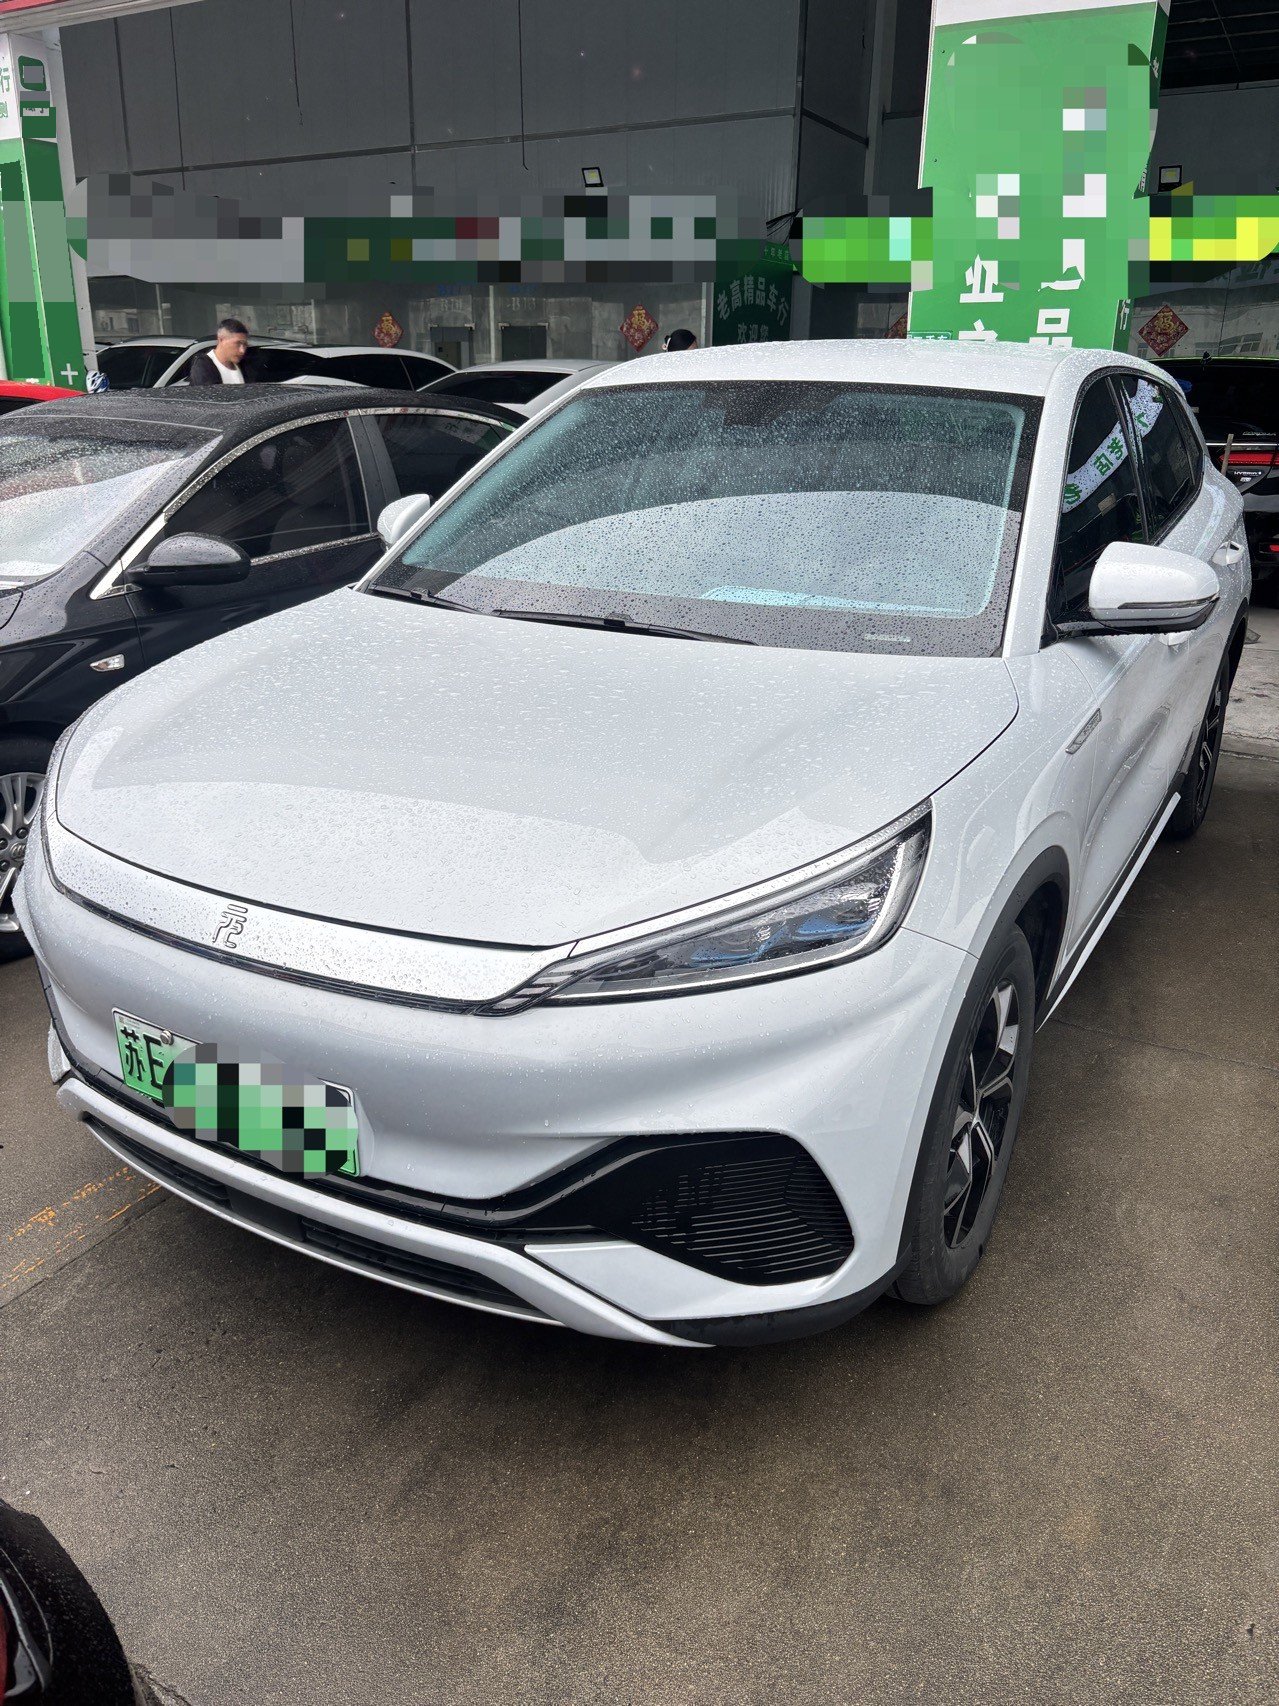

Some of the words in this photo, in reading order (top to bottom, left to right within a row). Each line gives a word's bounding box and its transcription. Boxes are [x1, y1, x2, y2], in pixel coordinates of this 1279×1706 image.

[717, 274, 789, 326] 老高精品车行
